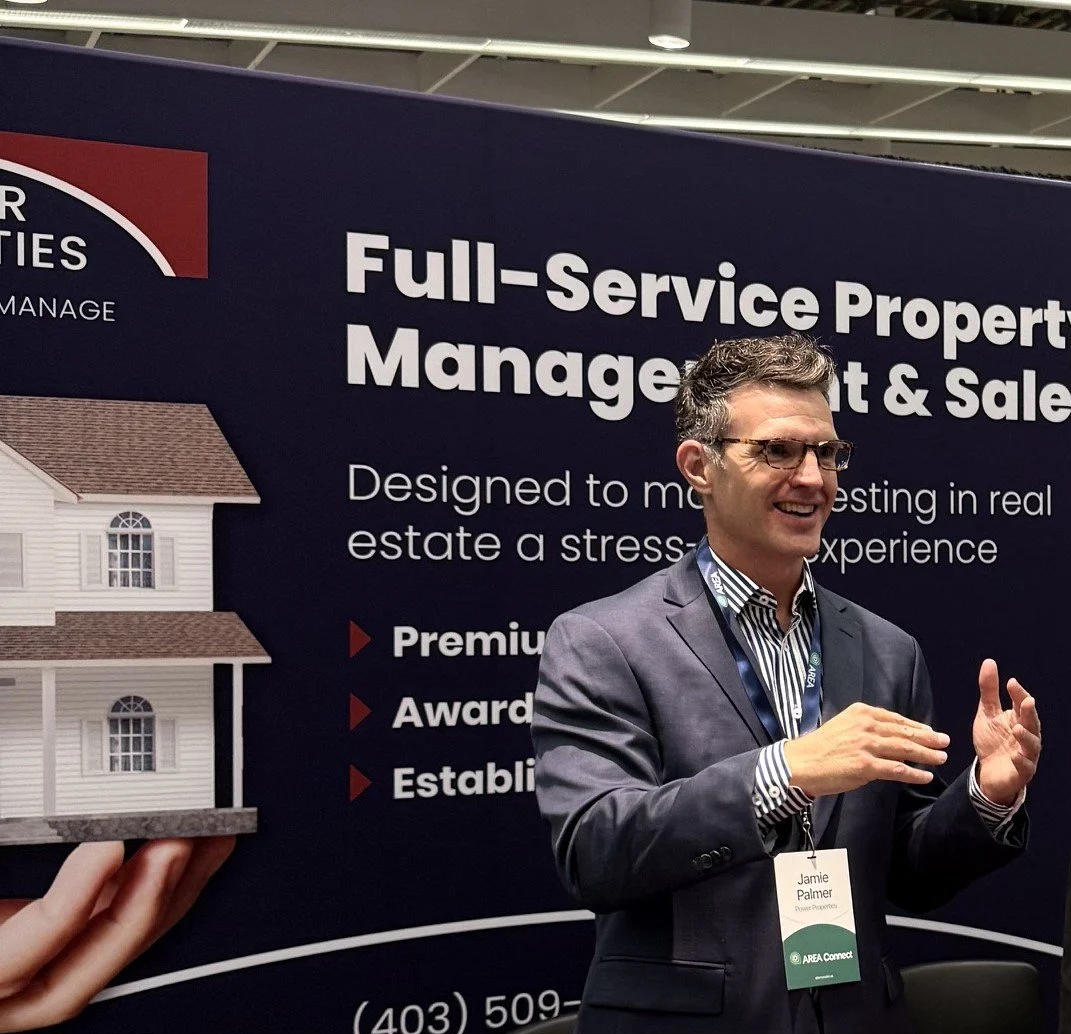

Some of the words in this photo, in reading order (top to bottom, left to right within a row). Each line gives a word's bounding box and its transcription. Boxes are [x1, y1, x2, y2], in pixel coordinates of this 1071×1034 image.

[346, 231, 820, 331] Full-Service
[347, 323, 869, 421] Managet
[883, 363, 933, 417] &
[349, 464, 571, 516] Designed
[586, 473, 628, 508] to
[950, 481, 977, 515] in
[990, 484, 1052, 516] real
[348, 525, 501, 562] estate
[516, 533, 545, 563] a
[710, 571, 726, 595] AREA
[393, 621, 545, 658] Premiu
[806, 664, 817, 688] AREA
[393, 758, 536, 800] Establi
[797, 872, 829, 886] Jamie
[797, 888, 832, 901] Palmer
[795, 905, 811, 913] Power
[812, 903, 838, 912] Properties
[802, 953, 822, 964] AREA
[823, 951, 853, 962] Connect
